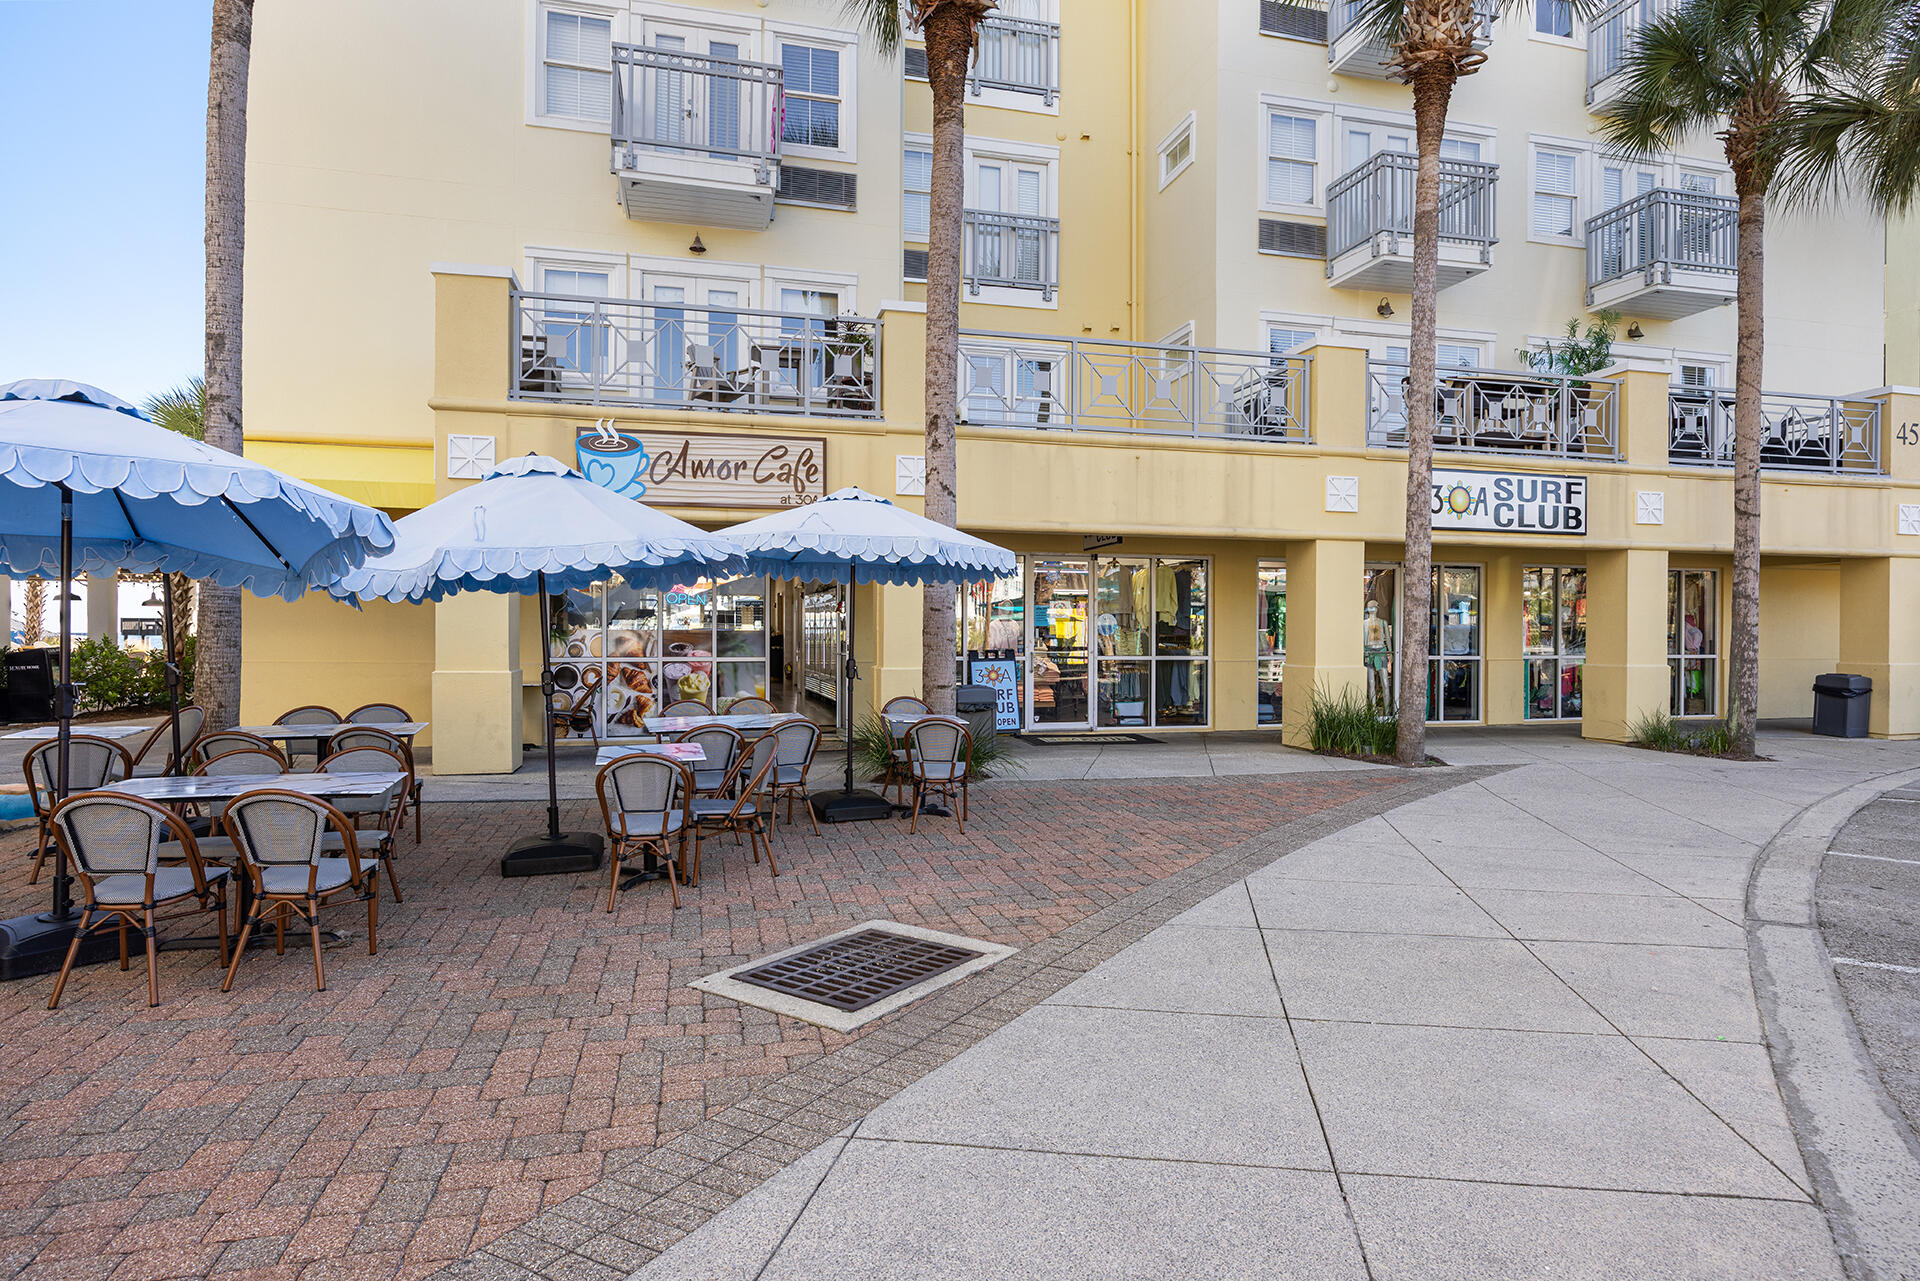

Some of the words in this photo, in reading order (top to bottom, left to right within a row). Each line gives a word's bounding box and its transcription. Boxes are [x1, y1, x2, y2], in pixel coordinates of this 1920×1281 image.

[650, 439, 748, 485] Amor
[753, 444, 819, 494] Cafe
[1493, 477, 1583, 505] SURF
[780, 494, 792, 505] at
[1493, 502, 1583, 530] CLUB
[665, 592, 707, 606] OPEN
[997, 688, 1013, 700] RF
[996, 702, 1015, 714] UB
[997, 717, 1017, 727] OPEN
